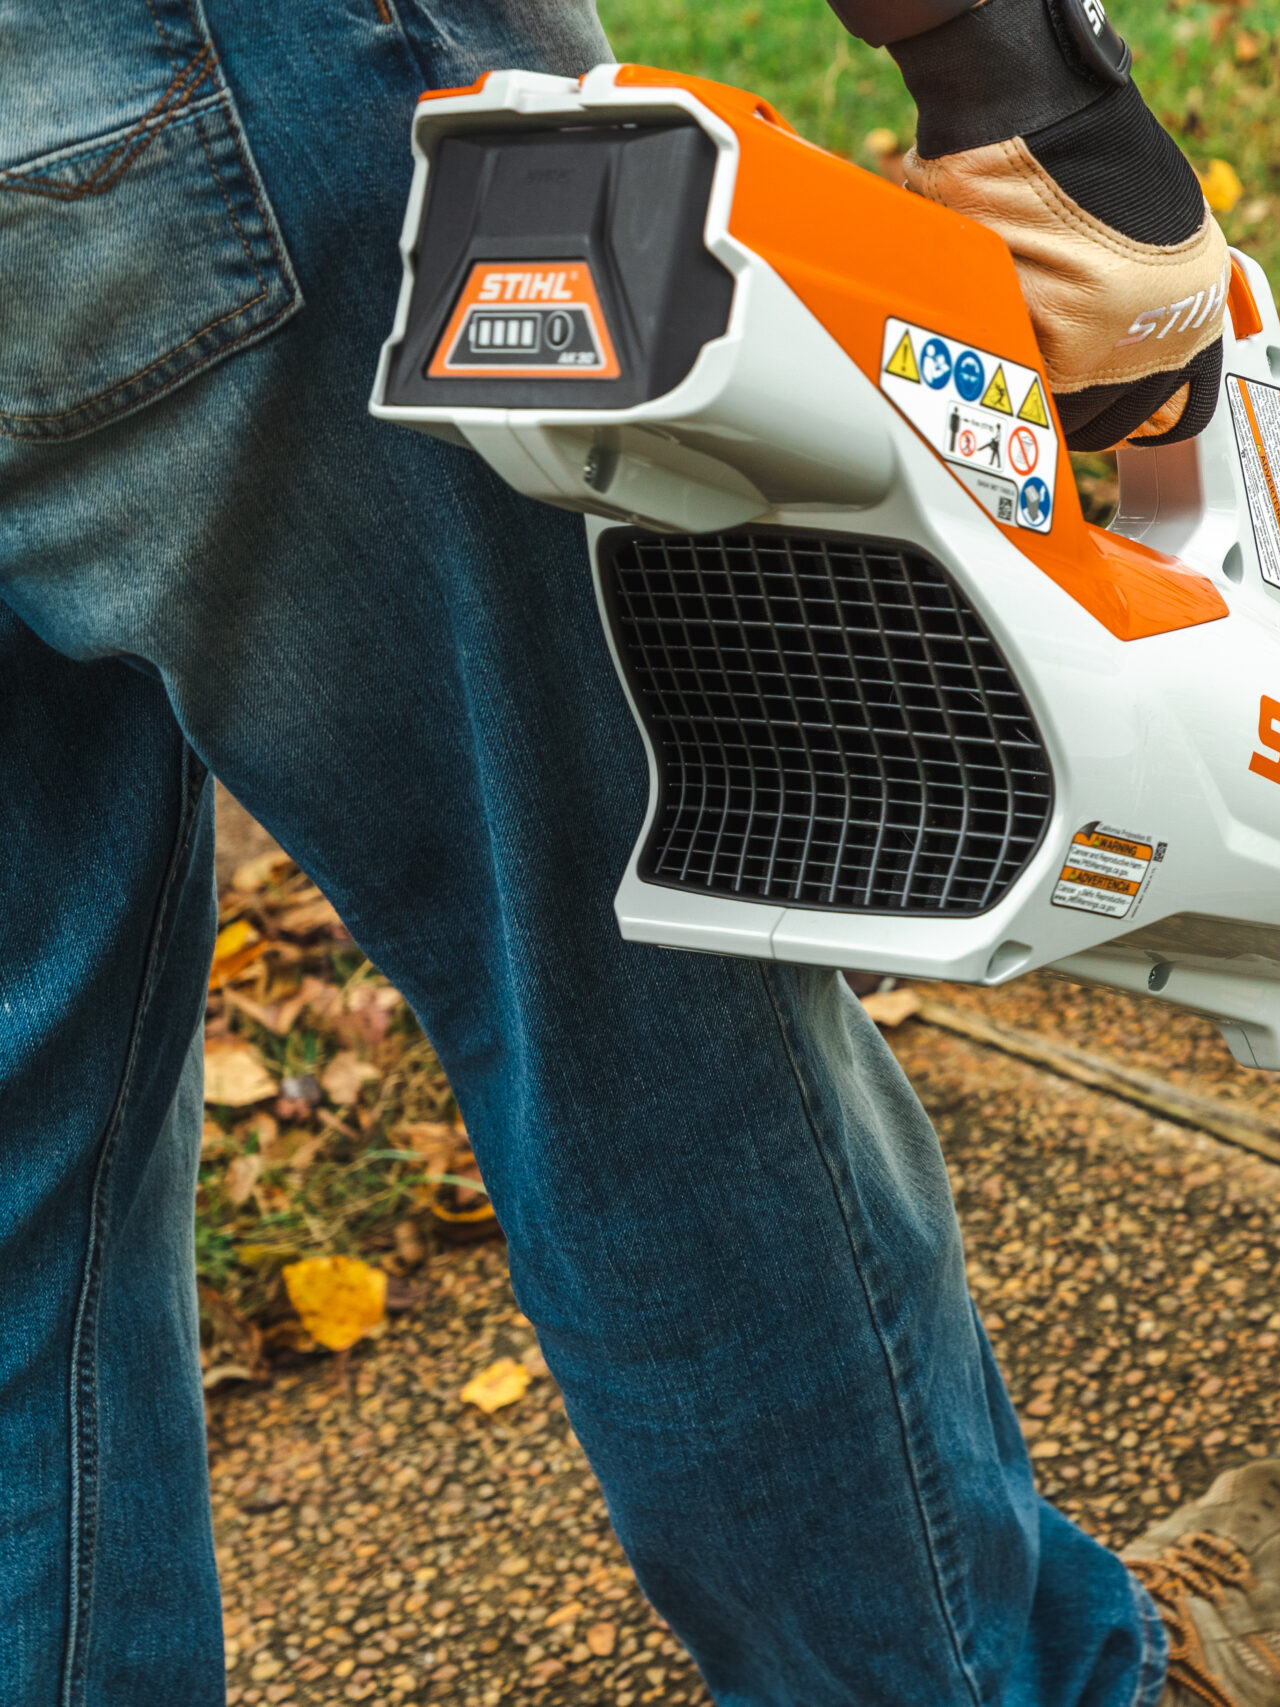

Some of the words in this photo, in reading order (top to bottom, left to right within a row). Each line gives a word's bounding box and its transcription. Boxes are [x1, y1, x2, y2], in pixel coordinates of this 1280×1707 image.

[478, 272, 572, 300] STIHL
[1100, 838, 1138, 857] WARNING
[1076, 871, 1130, 892] ADVERTENCIA
